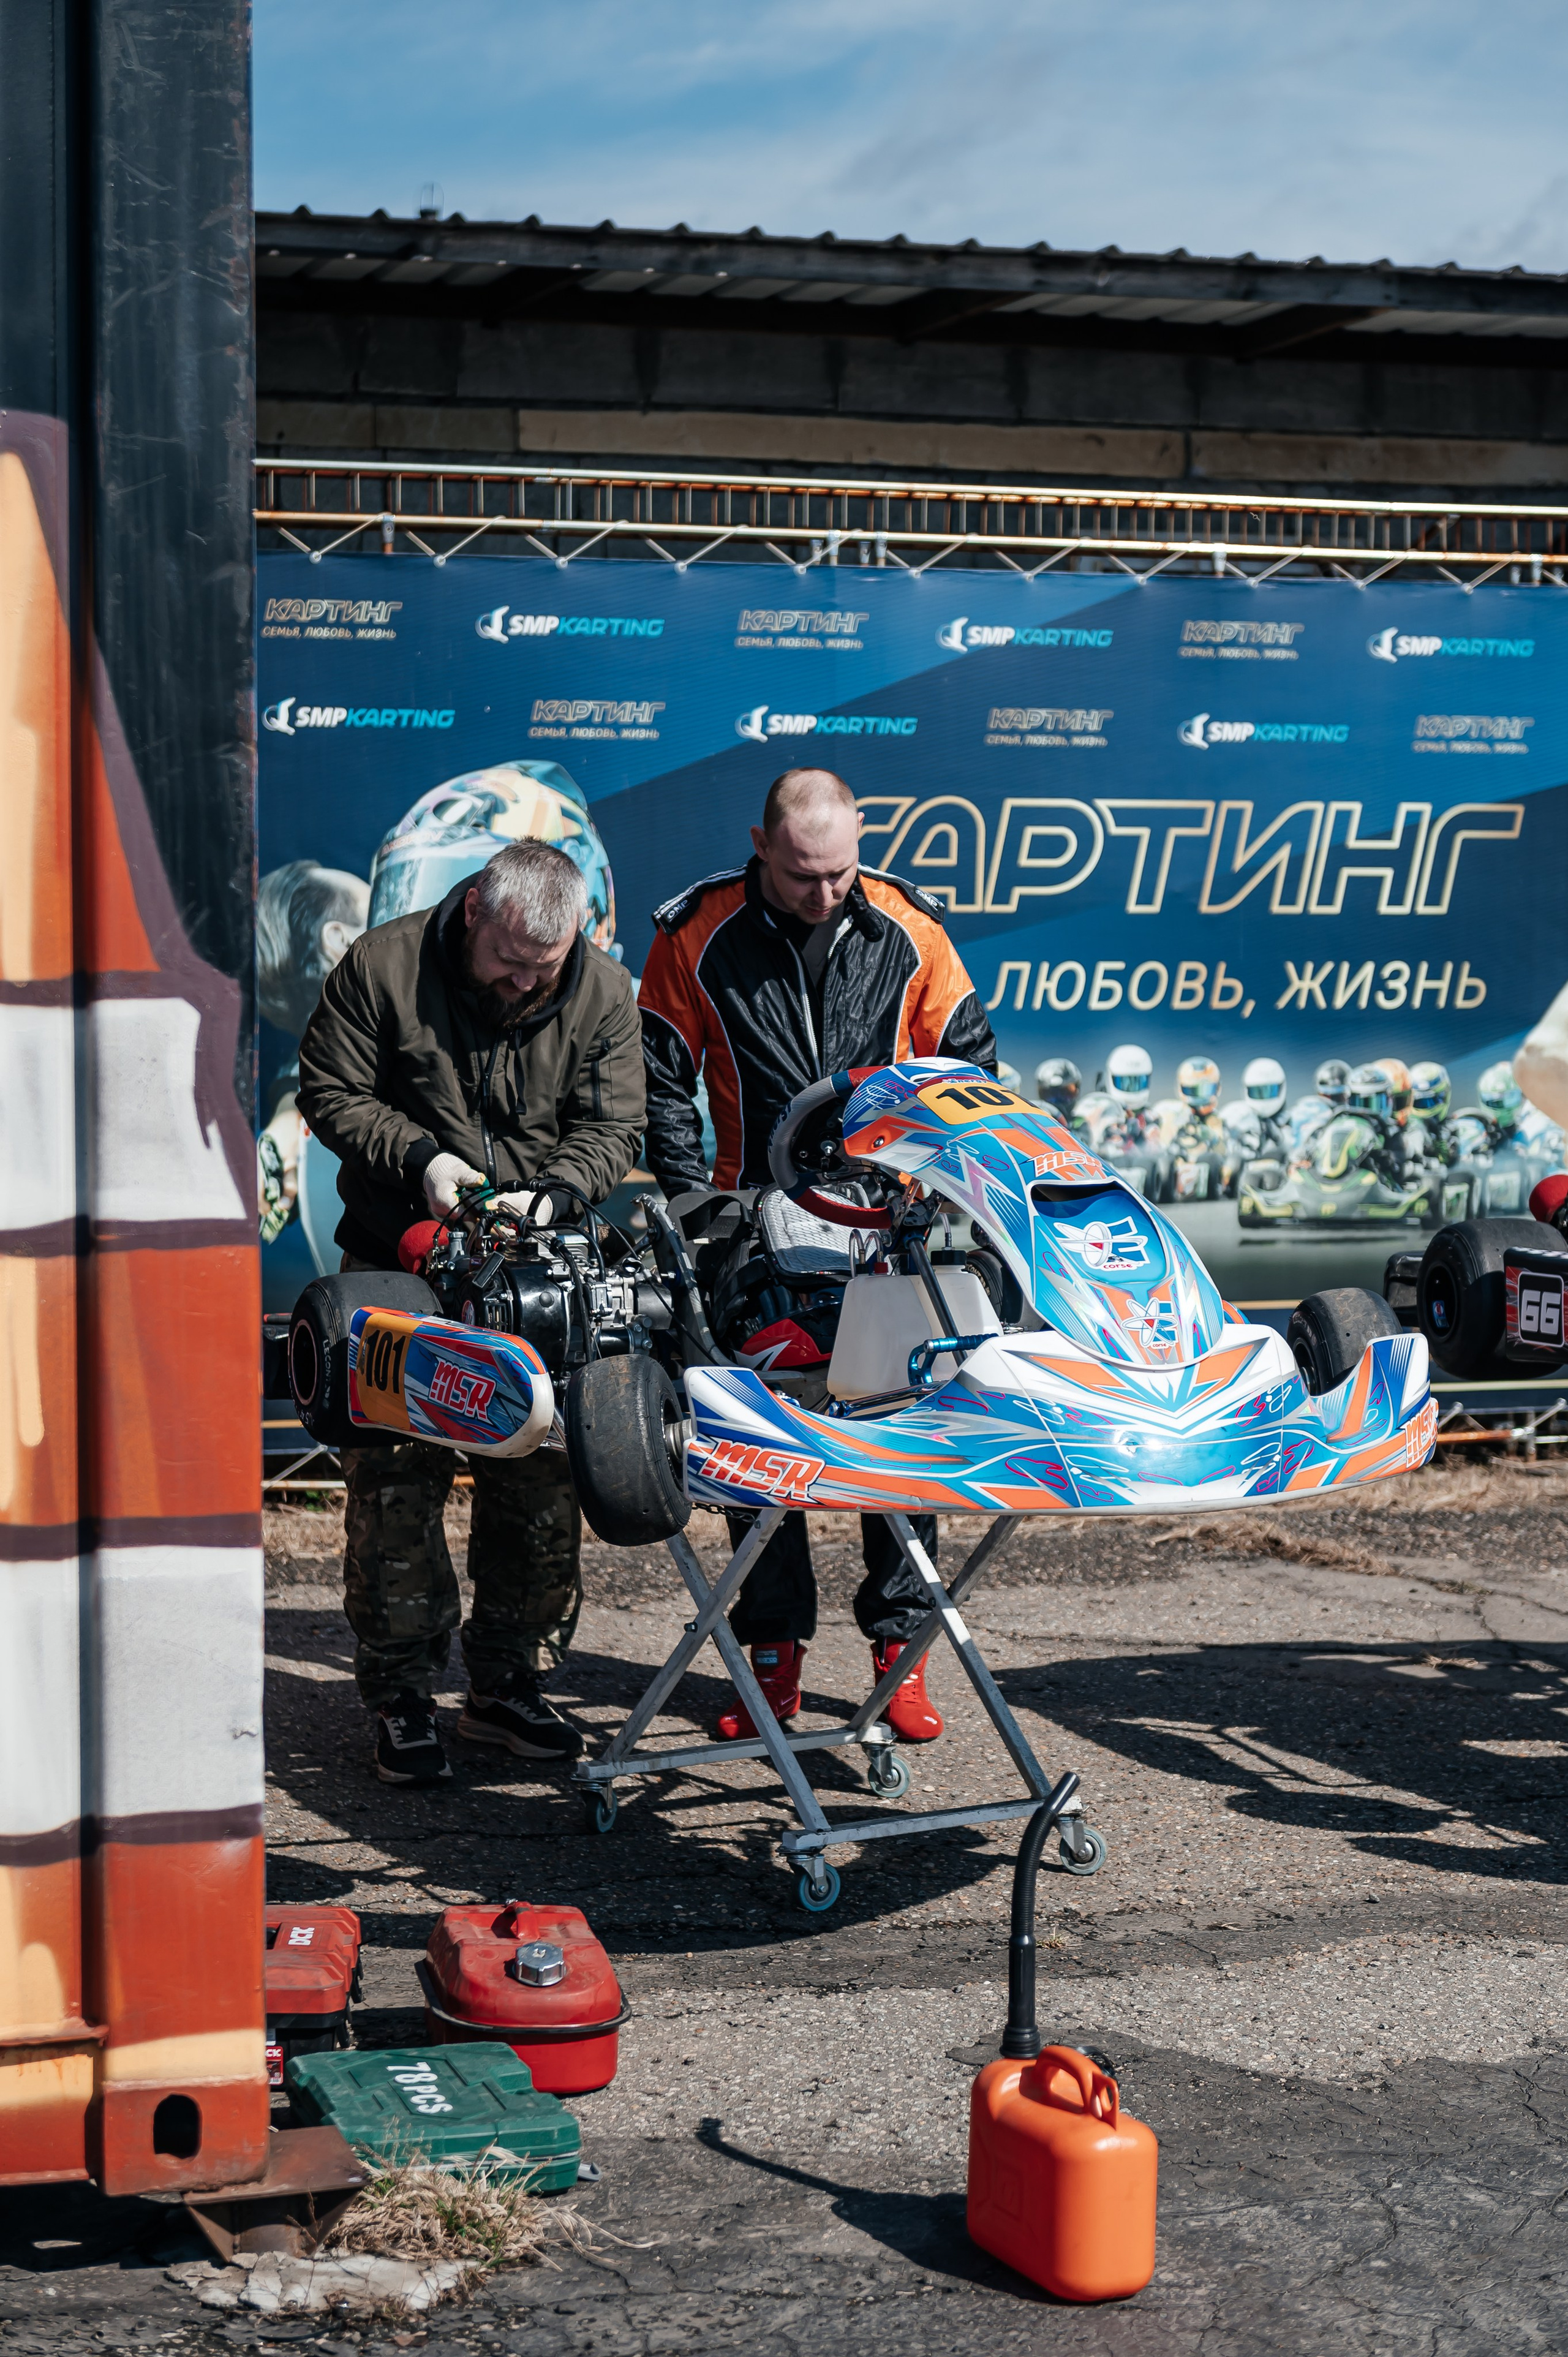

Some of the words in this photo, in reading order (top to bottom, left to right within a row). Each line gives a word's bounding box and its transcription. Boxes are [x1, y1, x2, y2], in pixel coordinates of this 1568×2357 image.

[263, 598, 402, 623] КАРТИНГ
[738, 610, 869, 633] КАРТИНГ
[262, 625, 302, 638] СЕМЬЯ,
[304, 626, 353, 639] ЛЮБОВЬ,
[356, 628, 397, 639] ЖИЗНЬ
[736, 636, 774, 647] СЕМЬЯ,
[777, 637, 824, 649] ЛЮБОВЬ,
[826, 638, 864, 650] ЖИЗНЬ
[1182, 620, 1305, 644] КАРТИНГ
[531, 700, 665, 724] КАРТИНГ
[988, 707, 1114, 732] КАРТИНГ
[529, 726, 568, 738] СЕМЬЯ,
[569, 727, 617, 739] ЛЮБОВЬ,
[620, 728, 660, 740] ЖИЗНЬ
[1414, 715, 1535, 739] КАРТИНГ
[668, 899, 688, 919] OMP
[915, 889, 938, 908] OMP
[987, 960, 1256, 1018] ЛЮБОВЬ,
[1275, 960, 1487, 1009] ЖИЗНЬ
[1521, 1289, 1561, 1335] 66
[366, 1329, 406, 1395] 101
[430, 1359, 497, 1421] MSR
[699, 1439, 824, 1499] MSR
[288, 1927, 315, 1946] DCK
[265, 2049, 282, 2057] CK
